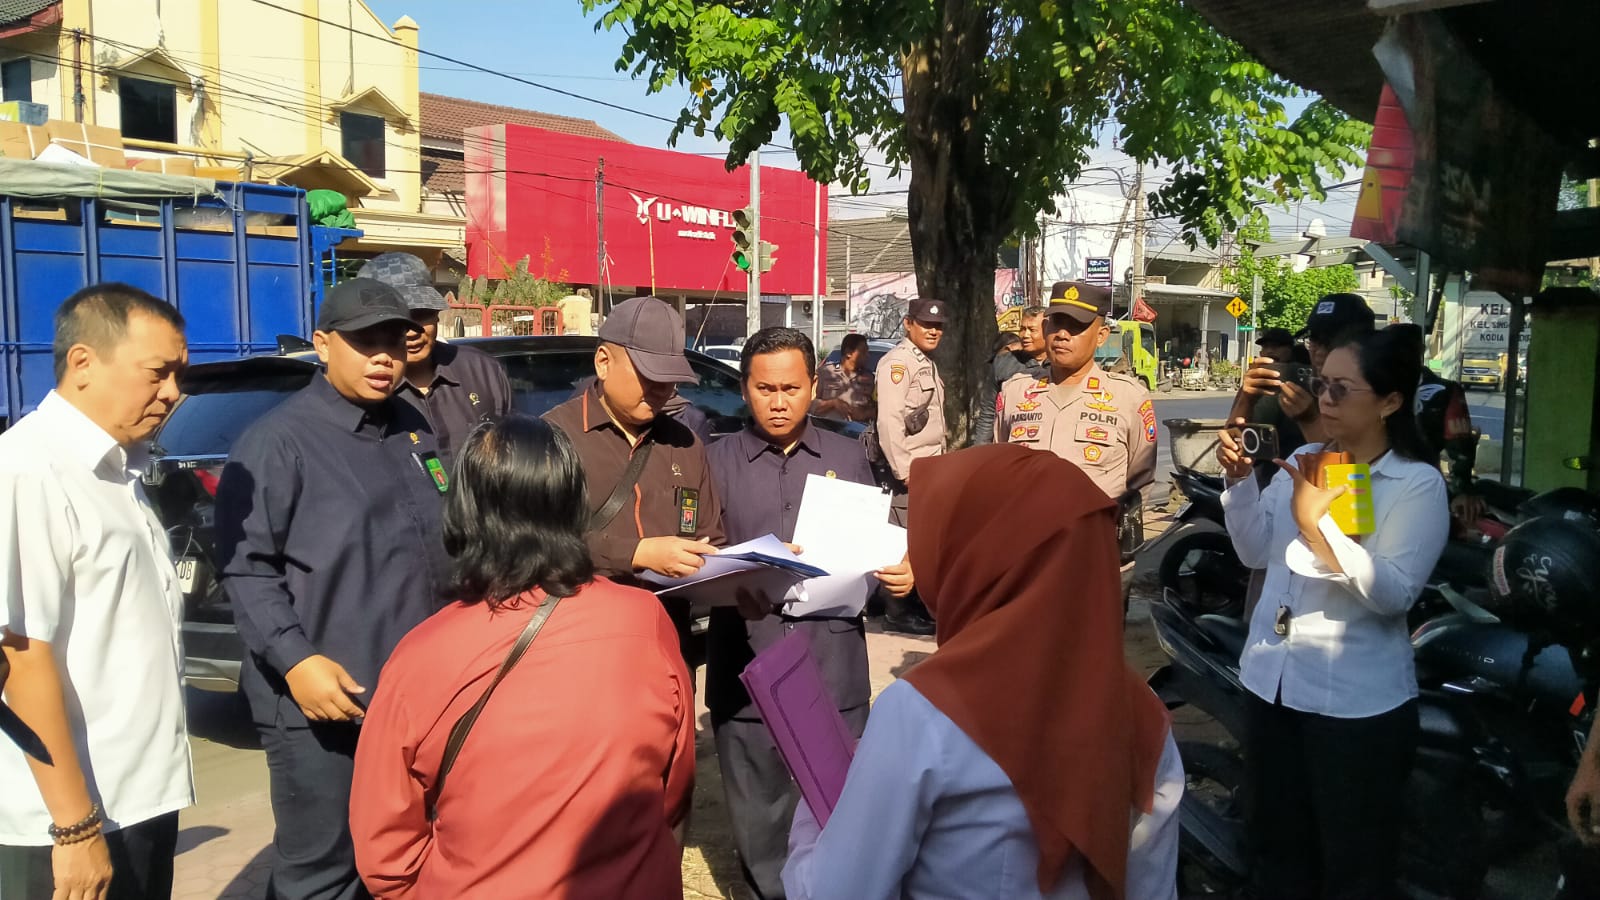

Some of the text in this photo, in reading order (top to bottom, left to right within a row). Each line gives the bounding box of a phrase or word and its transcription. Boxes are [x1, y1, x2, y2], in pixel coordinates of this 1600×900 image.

[681, 205, 738, 228] WINFL
[1480, 303, 1509, 316] KEL
[1079, 411, 1118, 426] POLRI
